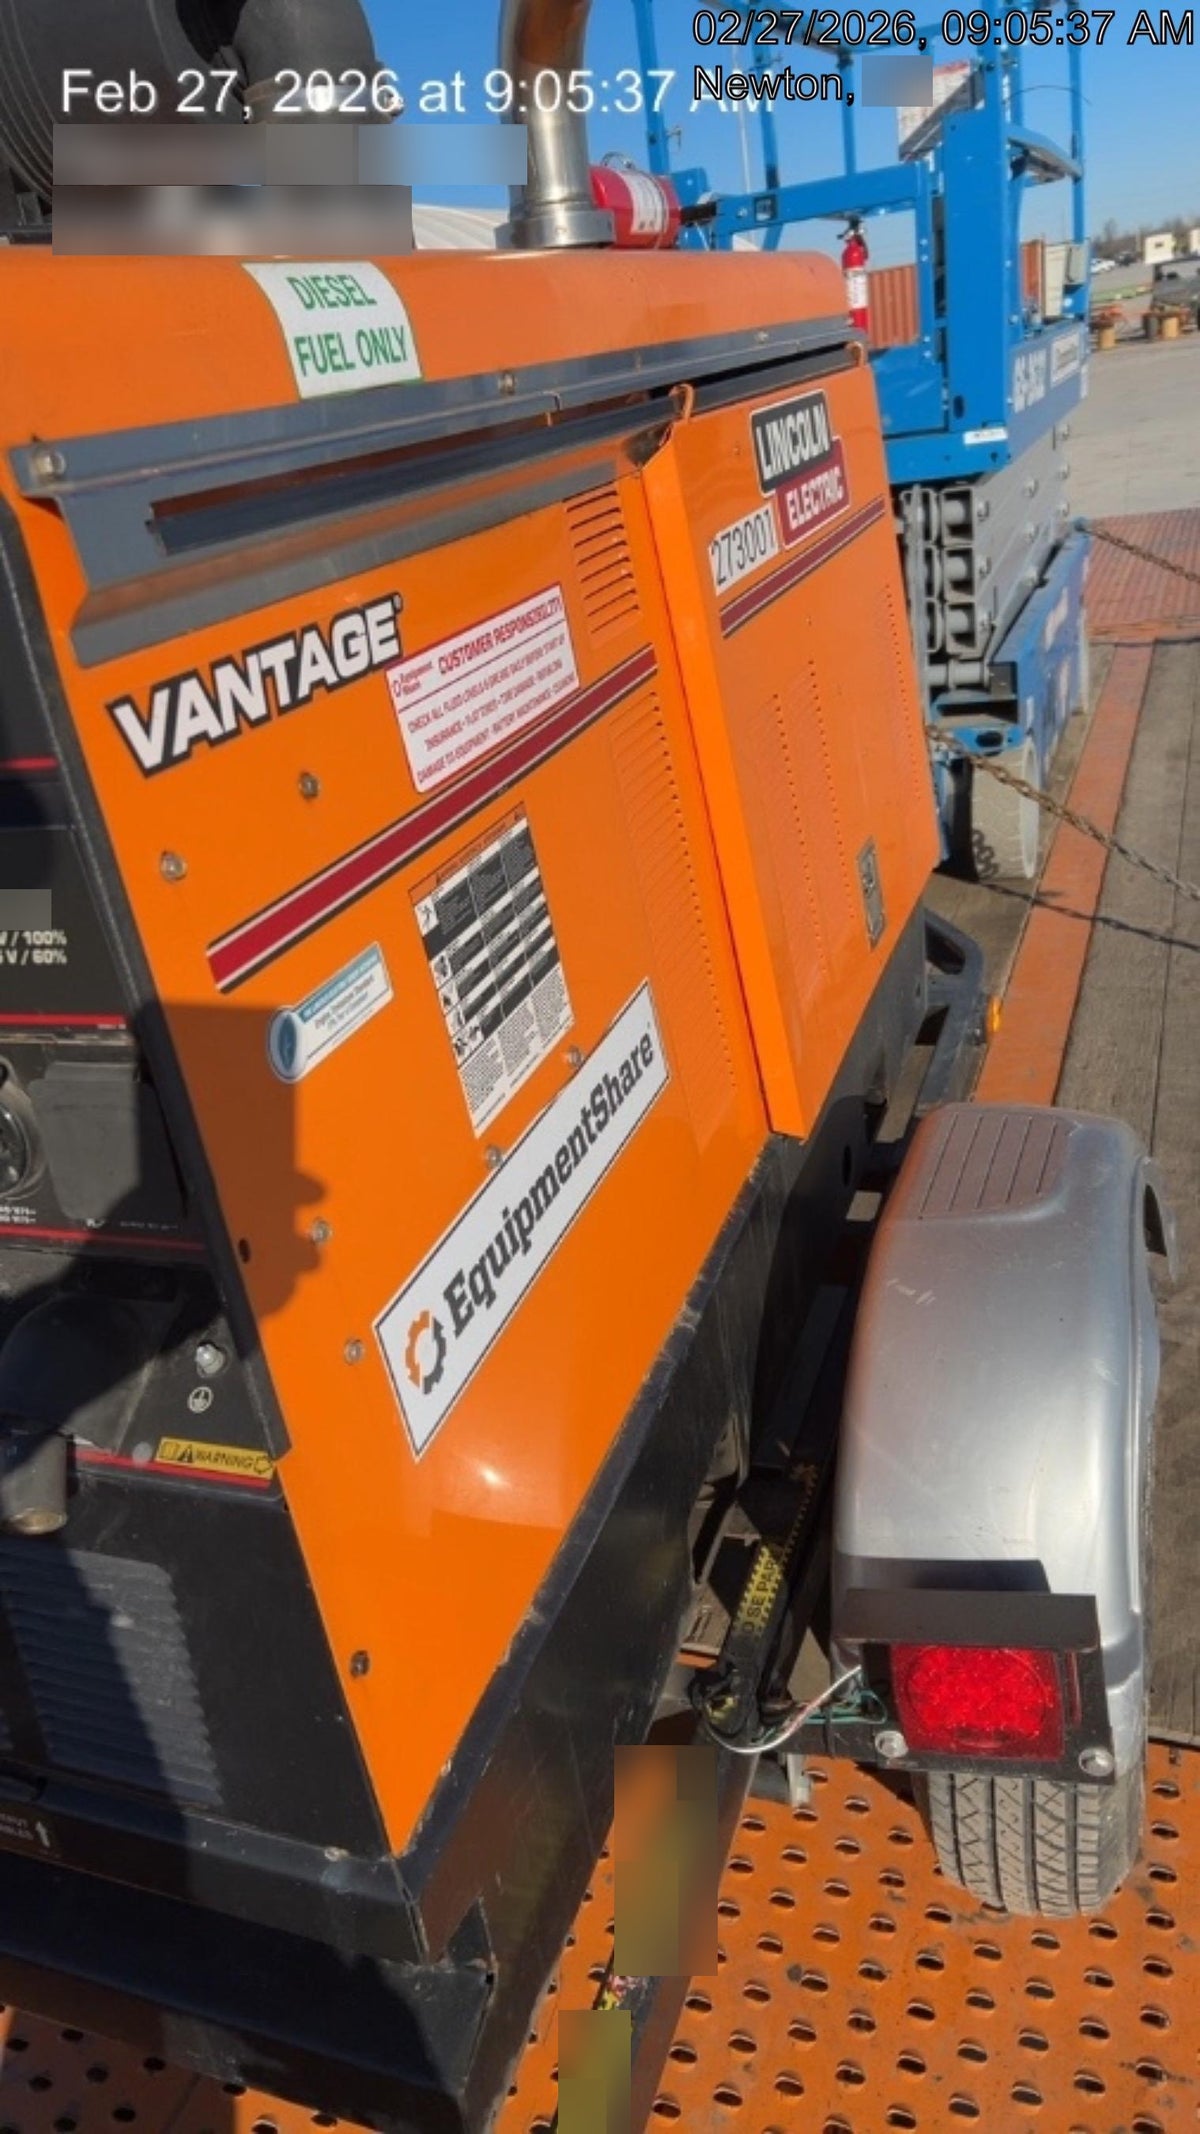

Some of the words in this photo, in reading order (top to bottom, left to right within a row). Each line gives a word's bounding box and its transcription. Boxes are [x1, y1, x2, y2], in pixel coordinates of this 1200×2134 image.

[286, 274, 378, 310] DIESEL
[294, 331, 356, 377] FUEL
[355, 325, 408, 368] ONLY
[756, 402, 831, 480] LINCOLN
[785, 466, 844, 530] ELECTRIC
[711, 508, 775, 586] 273001
[437, 632, 494, 675] CUSTOMER
[494, 596, 563, 644] RESPONSIBILITY
[108, 594, 402, 776] VANTAGE
[21, 929, 68, 946] 100%
[442, 1032, 654, 1339] EquipmentShare
